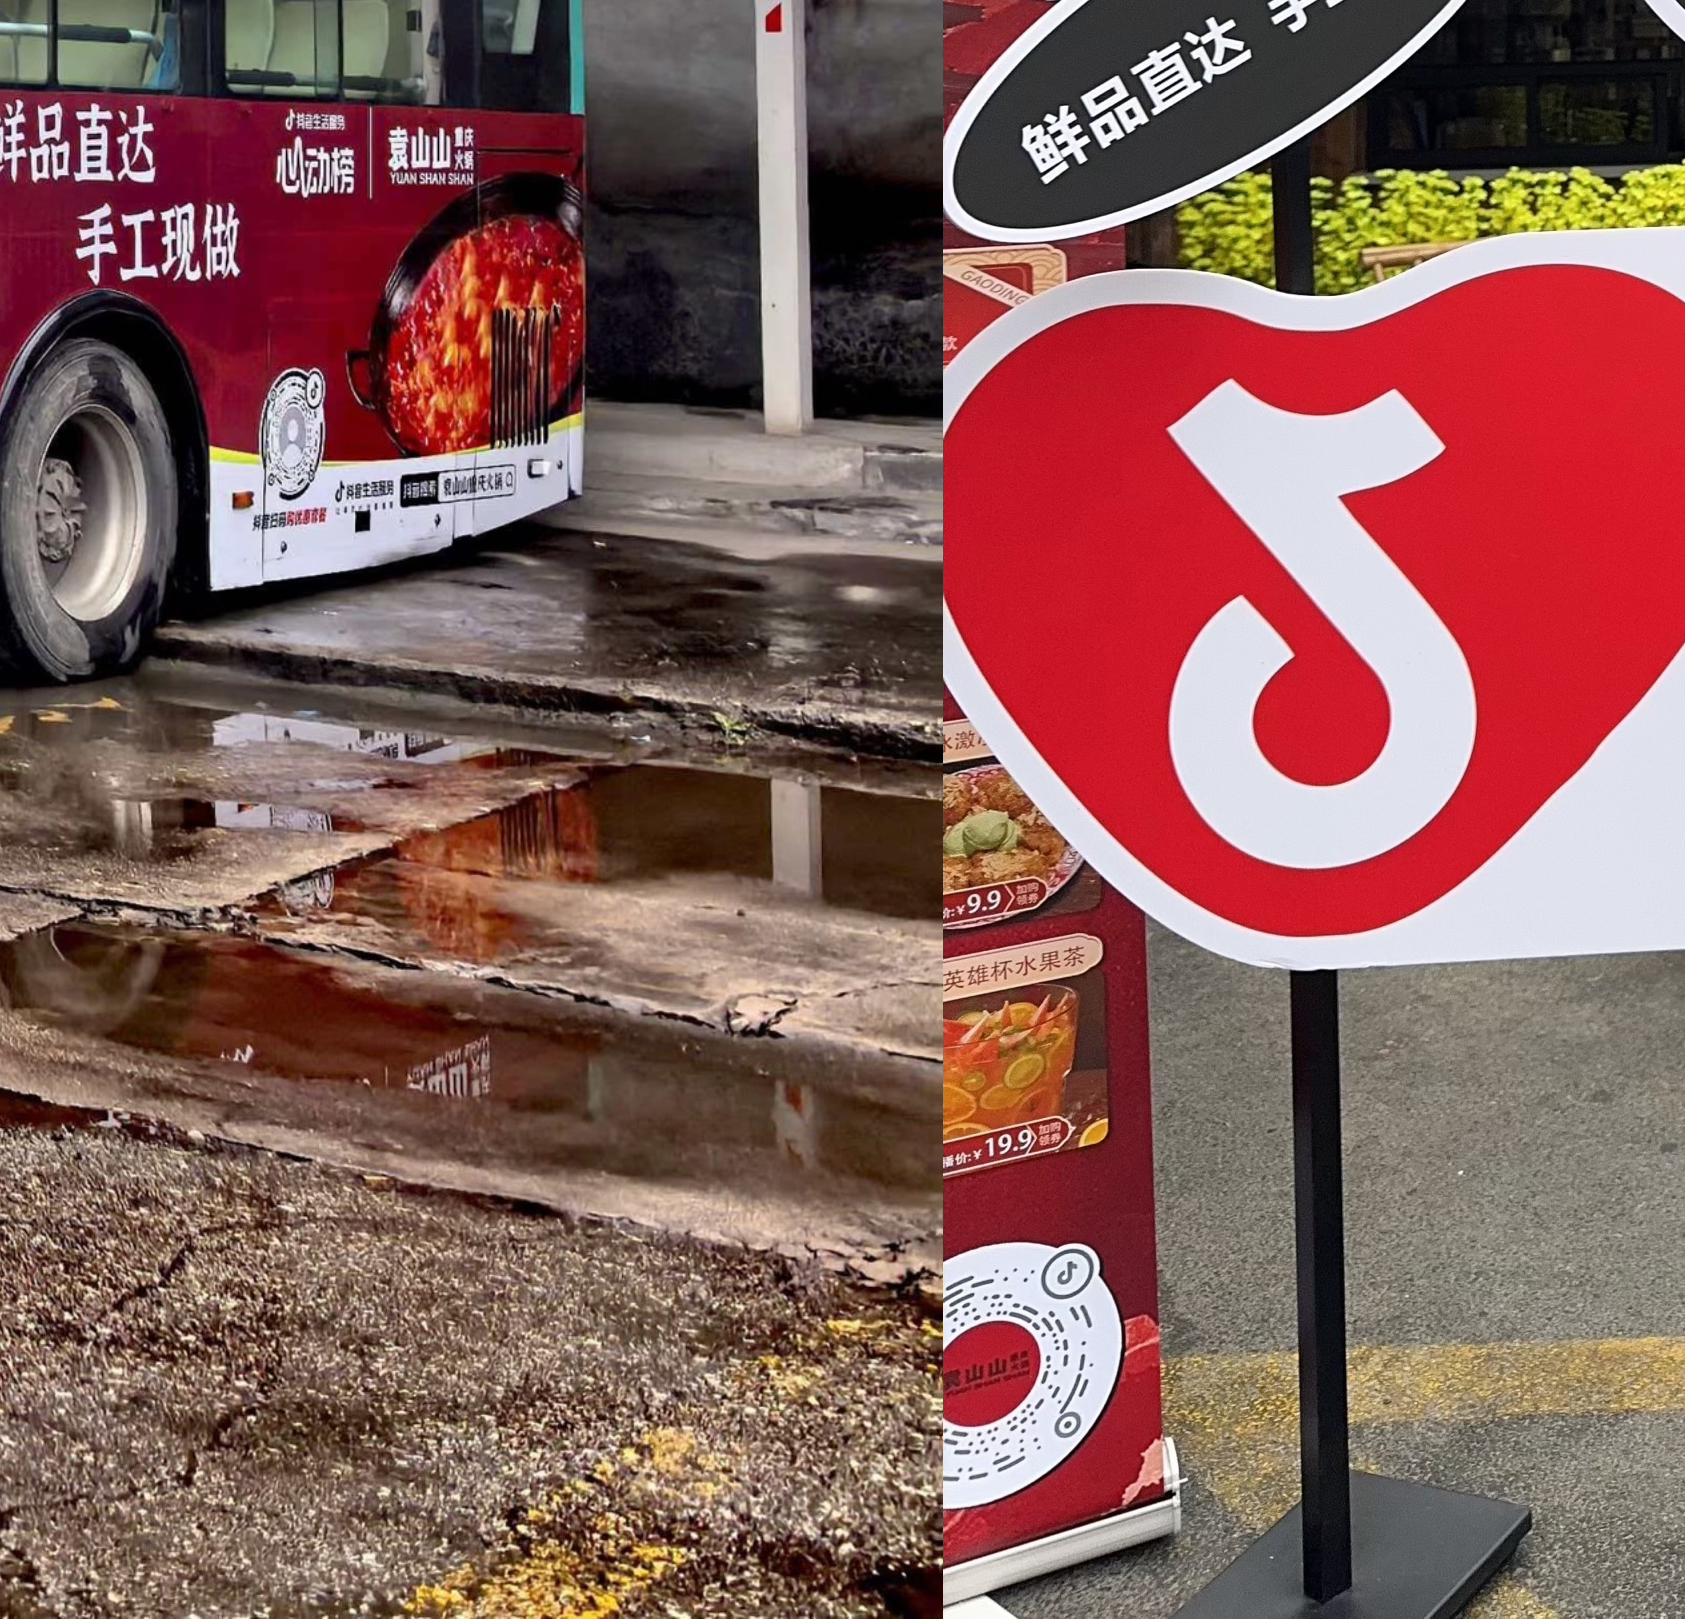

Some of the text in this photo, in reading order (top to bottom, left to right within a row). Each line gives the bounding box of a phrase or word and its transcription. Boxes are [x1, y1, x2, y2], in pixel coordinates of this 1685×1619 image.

[1020, 15, 1254, 185] 鲜品直达
[296, 113, 346, 131] 抖音生活服务
[454, 127, 474, 148] 重庆
[276, 135, 356, 199] 心动榜
[388, 126, 452, 172] 袁山山
[454, 150, 474, 171] 火锅
[390, 171, 474, 186] YUAN SHAN SHAN
[75, 202, 241, 284] 手工现做
[960, 269, 1030, 306] GAODING
[345, 479, 395, 501] 抖音生活服务
[943, 945, 1086, 992] 英雄杯水果茶
